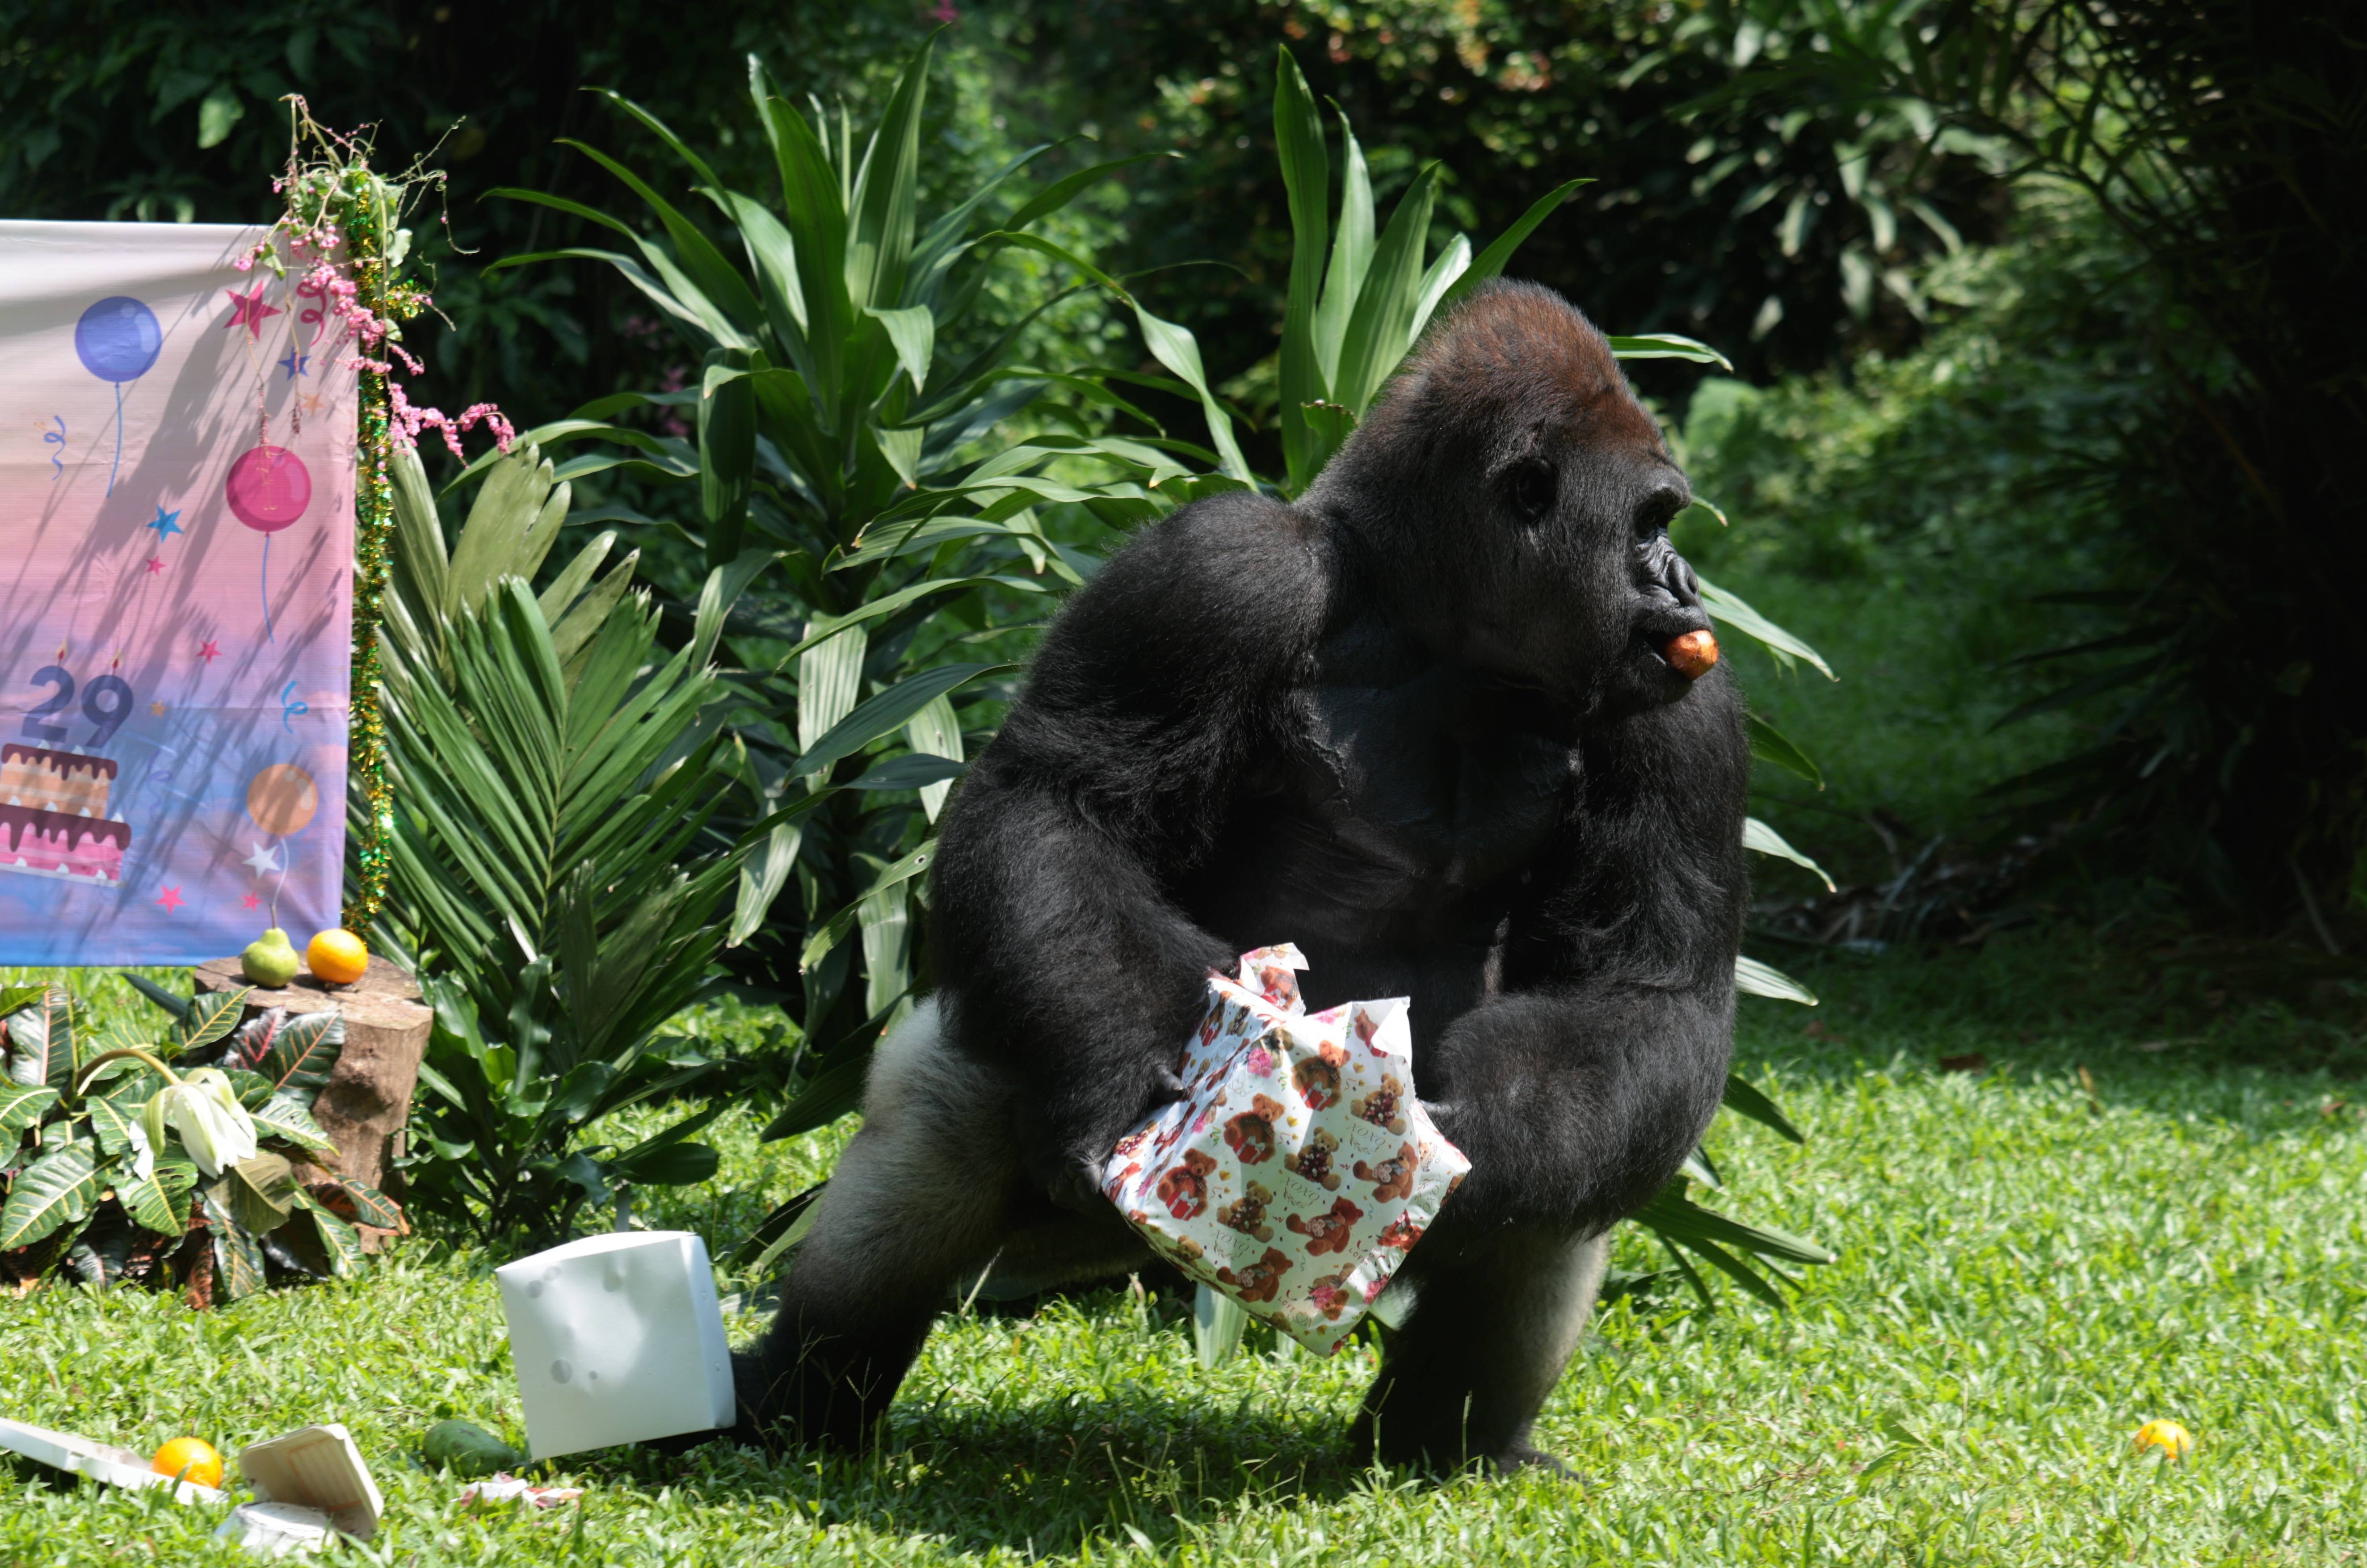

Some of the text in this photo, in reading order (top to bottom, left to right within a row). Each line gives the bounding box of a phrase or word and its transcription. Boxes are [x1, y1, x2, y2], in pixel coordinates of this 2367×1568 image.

[20, 665, 133, 749] 29
[1346, 1123, 1386, 1146] XOXO
[1280, 1177, 1320, 1201] XOXO
[1210, 1230, 1249, 1251] XOXO
[1278, 1297, 1295, 1312] LOVE
